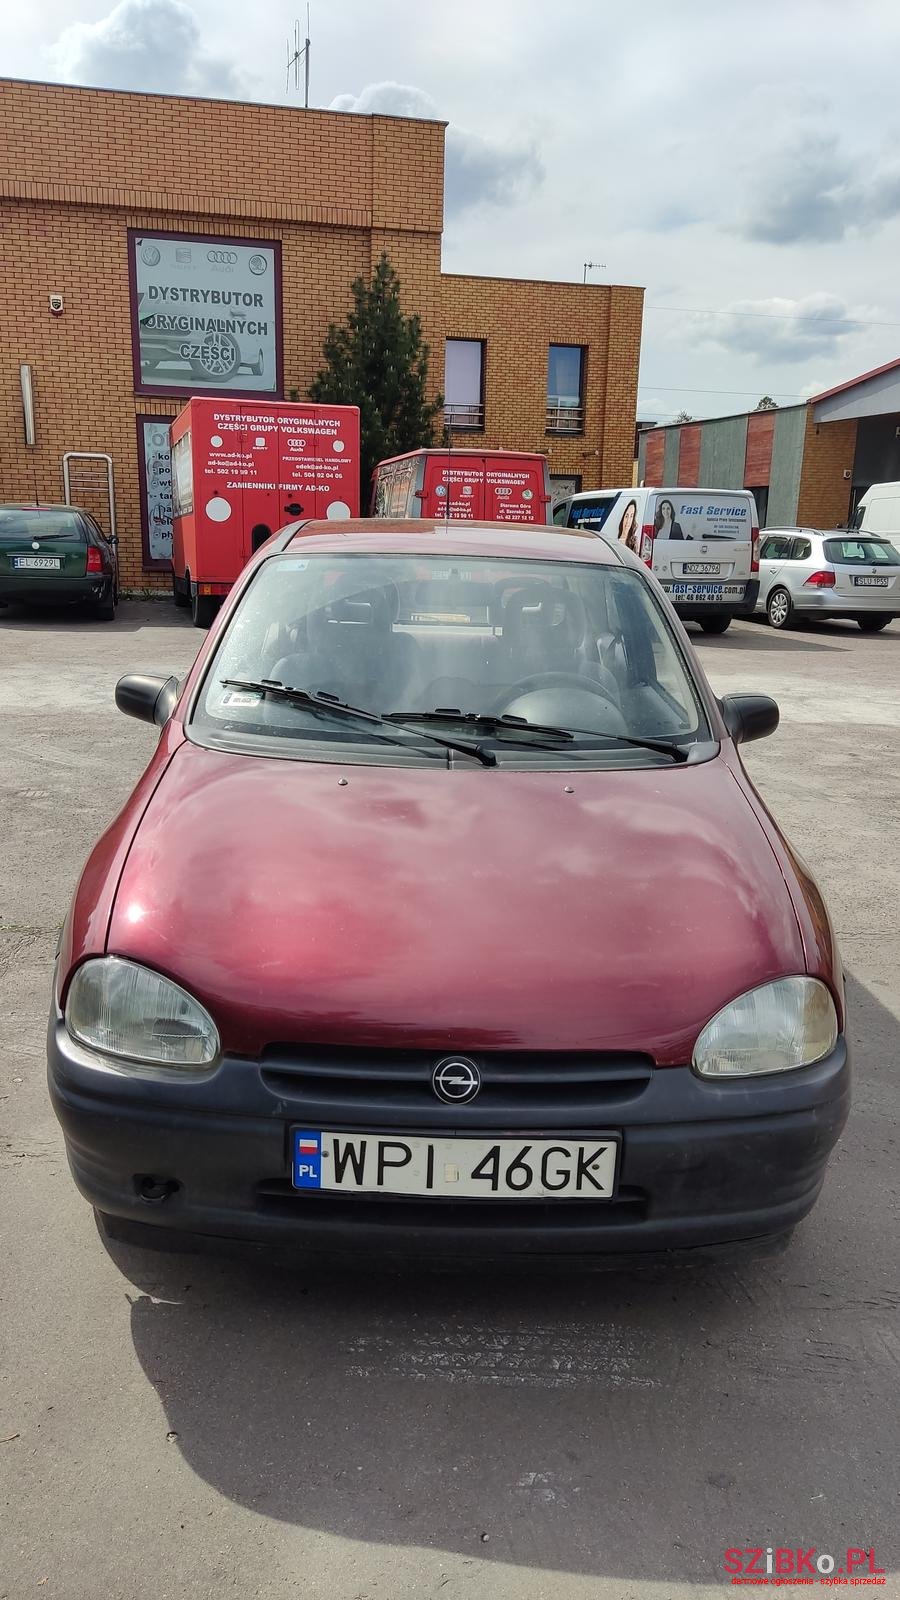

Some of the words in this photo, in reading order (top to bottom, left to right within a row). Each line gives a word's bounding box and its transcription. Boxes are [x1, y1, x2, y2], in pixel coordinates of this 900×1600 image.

[148, 286, 264, 307] DYSTRYBUTOR
[146, 315, 268, 336] ORYGINALNYCH
[180, 343, 235, 362] CZĘŚCI
[214, 414, 275, 423] DYSTRYBUTOR
[278, 417, 340, 427] ORYGINALNYCH
[218, 422, 248, 431] CZĘŚCI
[281, 426, 338, 436] VOLKSWAGEN
[226, 482, 276, 490] ZAMIENNIKI
[680, 505, 704, 514] Fast
[706, 506, 746, 516] Service
[299, 1164, 318, 1178] PL
[333, 1138, 434, 1189] WPI
[471, 1145, 609, 1191] 46GK
